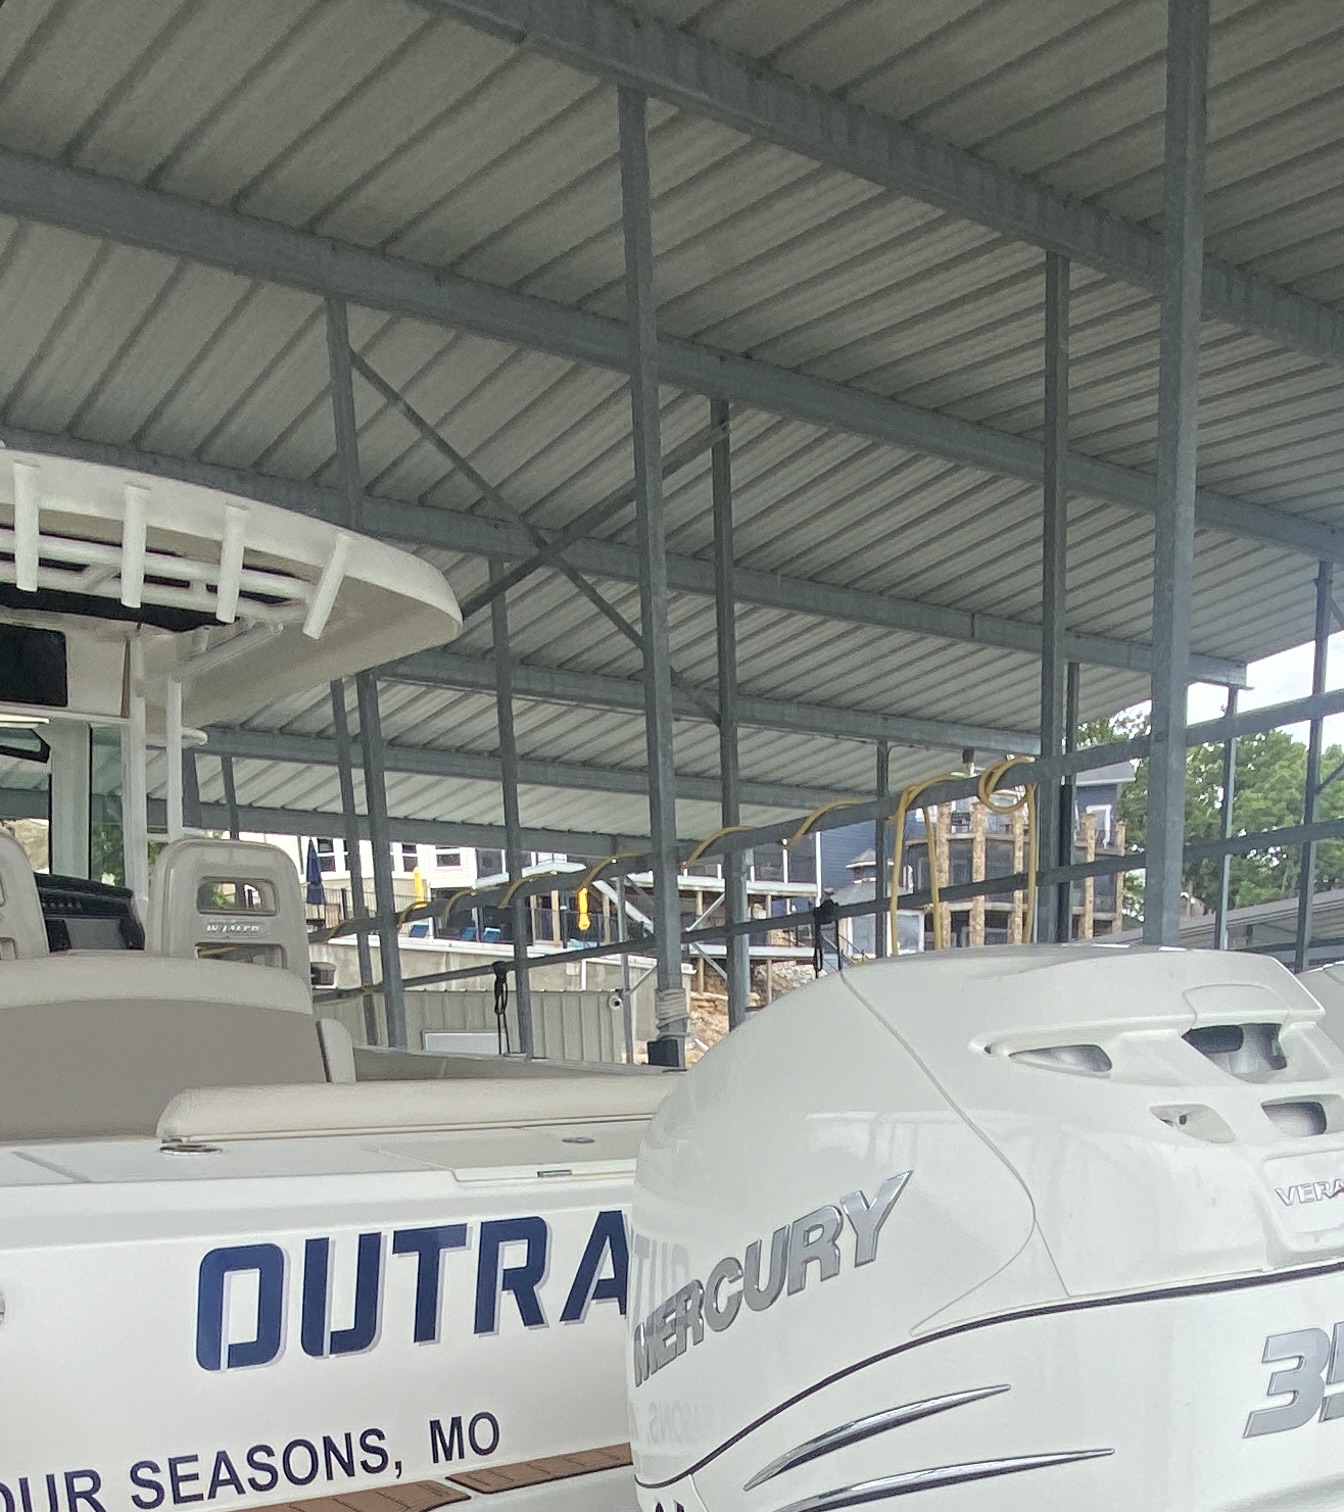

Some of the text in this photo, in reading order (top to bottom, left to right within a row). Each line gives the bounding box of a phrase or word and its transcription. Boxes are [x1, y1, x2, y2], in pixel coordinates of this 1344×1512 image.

[634, 1170, 913, 1387] MERCURY
[131, 1427, 402, 1510] SEASONS,
[429, 1412, 500, 1464] MO
